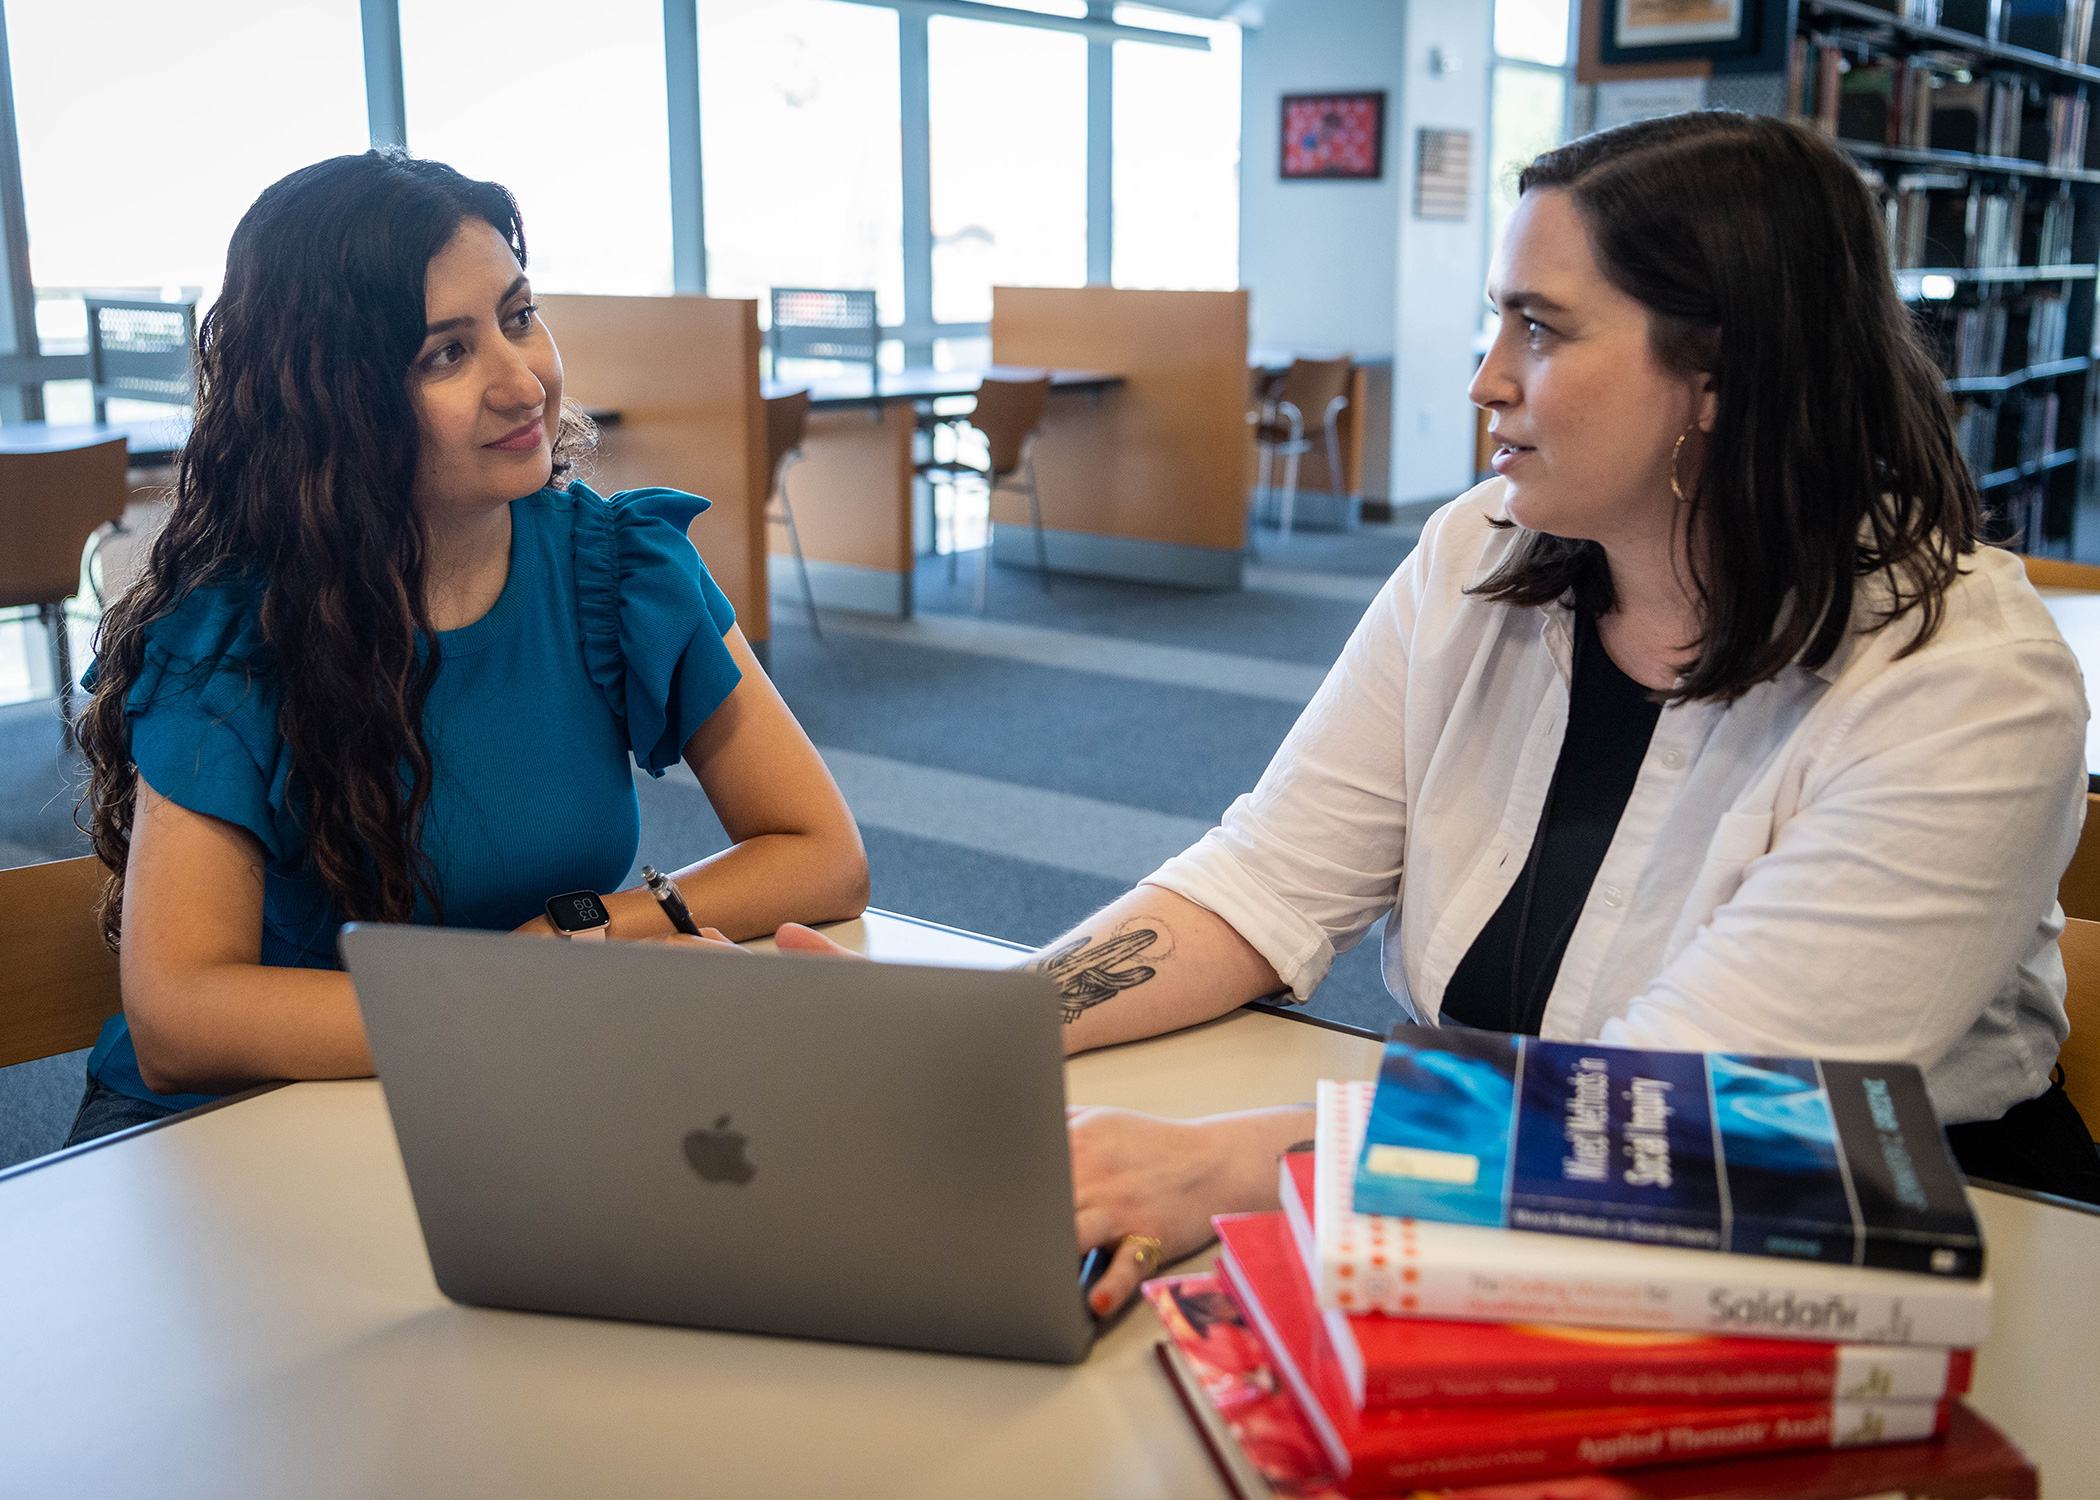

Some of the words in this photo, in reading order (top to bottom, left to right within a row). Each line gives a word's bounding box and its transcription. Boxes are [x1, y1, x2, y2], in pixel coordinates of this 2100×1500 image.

[1621, 1076, 1676, 1131] Inquiry
[1622, 1131, 1673, 1189] Social
[1577, 1430, 1663, 1464] Applied
[1667, 1420, 1768, 1450] Thematic
